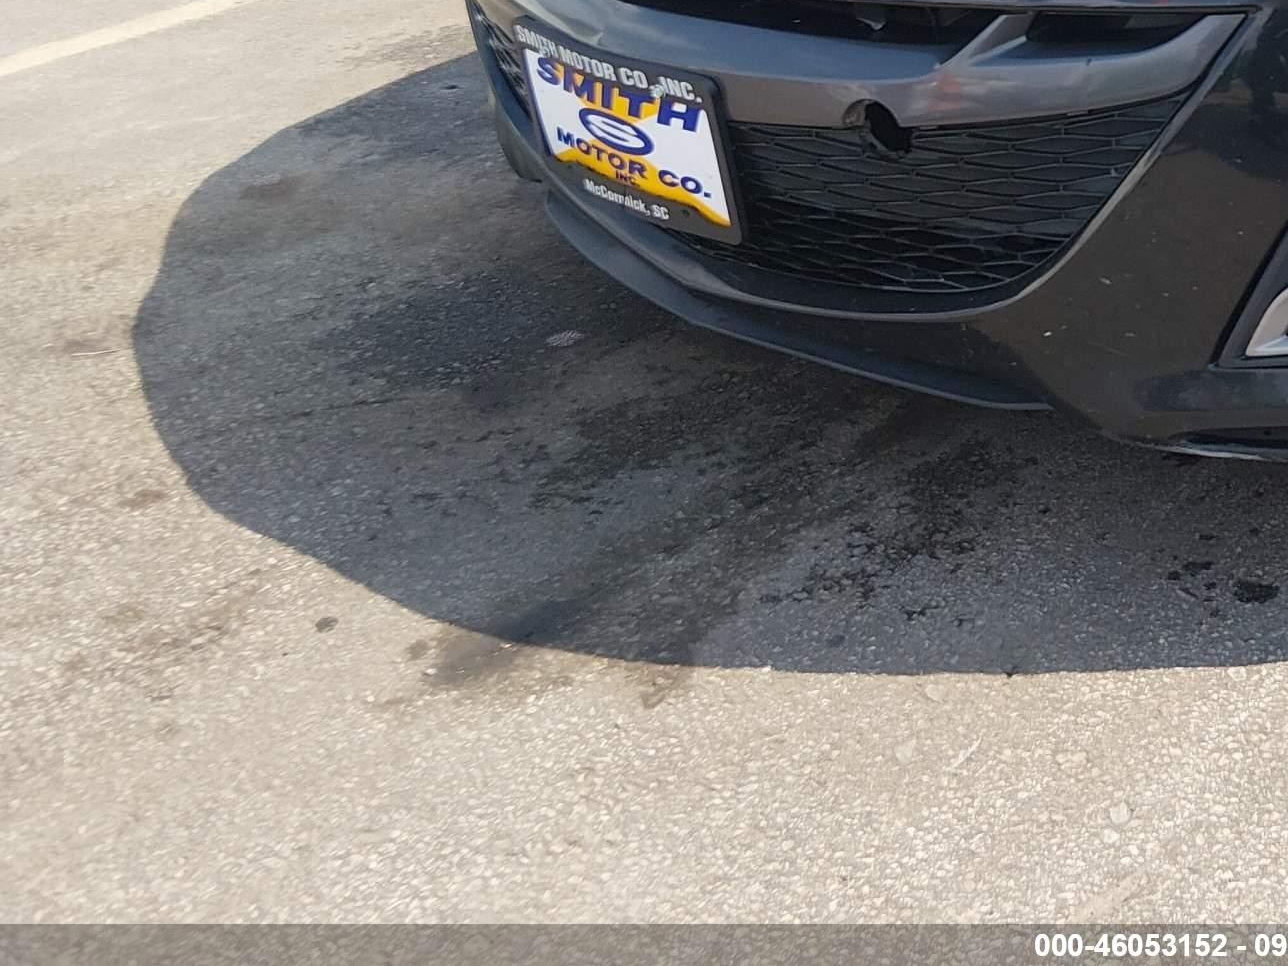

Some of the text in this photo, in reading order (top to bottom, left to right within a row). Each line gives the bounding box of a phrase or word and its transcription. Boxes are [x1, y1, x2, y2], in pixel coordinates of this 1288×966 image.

[558, 44, 617, 82] MOTOR
[536, 56, 700, 132] SMITH
[556, 126, 712, 199] MOTOR CO.
[652, 204, 670, 220] SC
